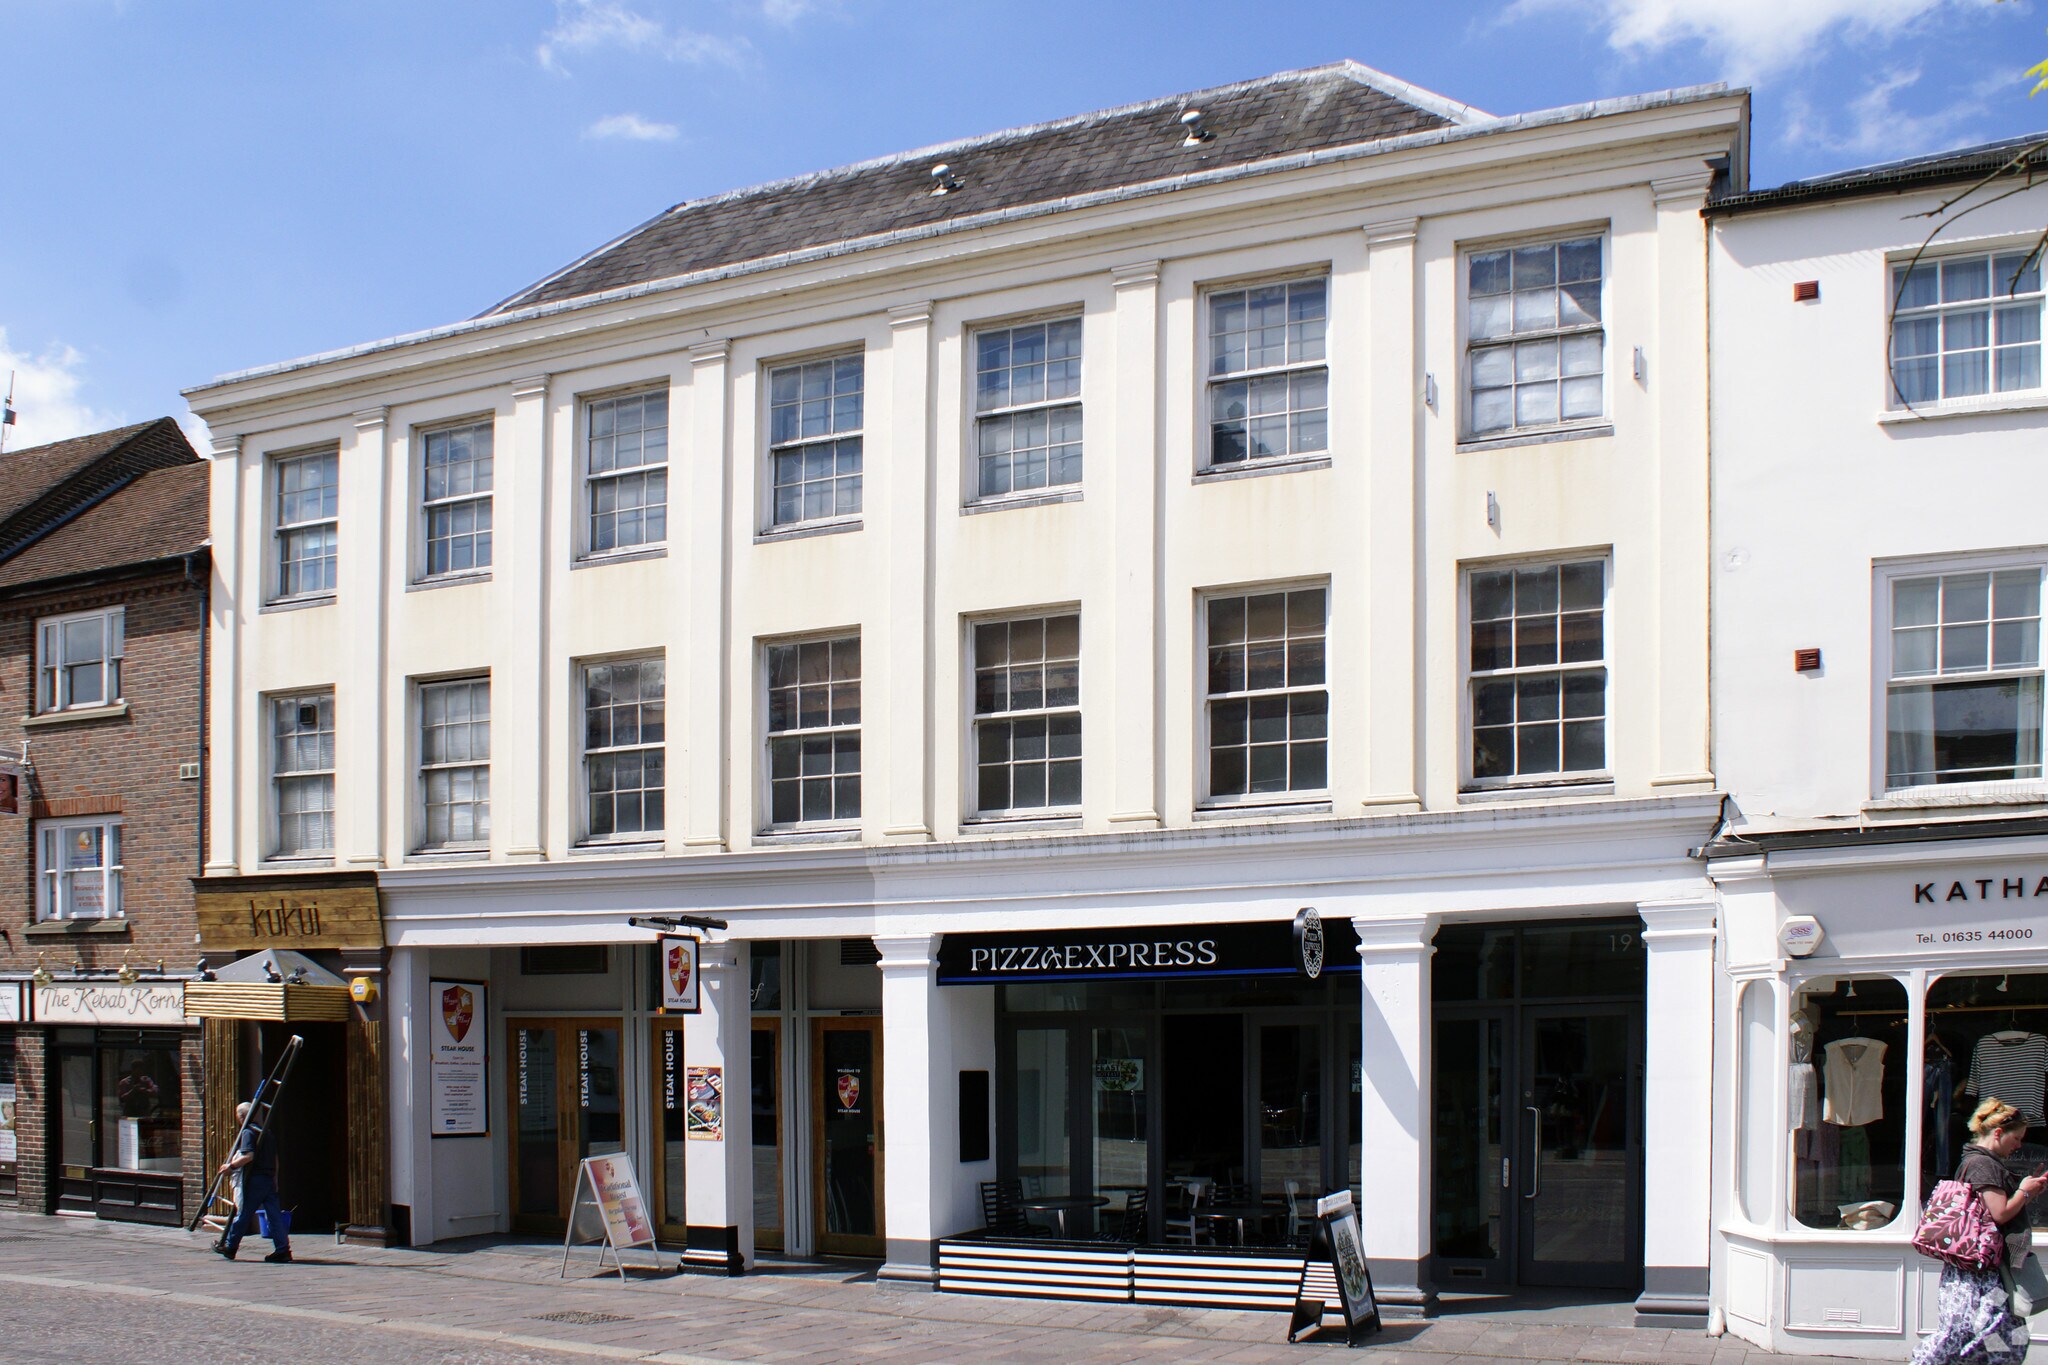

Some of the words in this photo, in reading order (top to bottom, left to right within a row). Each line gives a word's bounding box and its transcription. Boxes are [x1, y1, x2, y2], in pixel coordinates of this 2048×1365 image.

[250, 898, 322, 937] kukui
[1609, 933, 1632, 952] 19
[1916, 933, 1937, 944] Tel.
[1942, 931, 1982, 943] 01635
[1987, 928, 2034, 940] 44000
[41, 987, 69, 1015] The
[72, 987, 127, 1013] Kebab
[457, 1045, 475, 1053] HOUSE
[519, 1029, 528, 1068] HOUSE
[579, 1030, 589, 1070] HOUSE
[665, 1030, 675, 1071] HOUSE
[519, 1070, 528, 1105] STEAK
[580, 1072, 589, 1107] STEAK
[666, 1073, 675, 1109] STEAK
